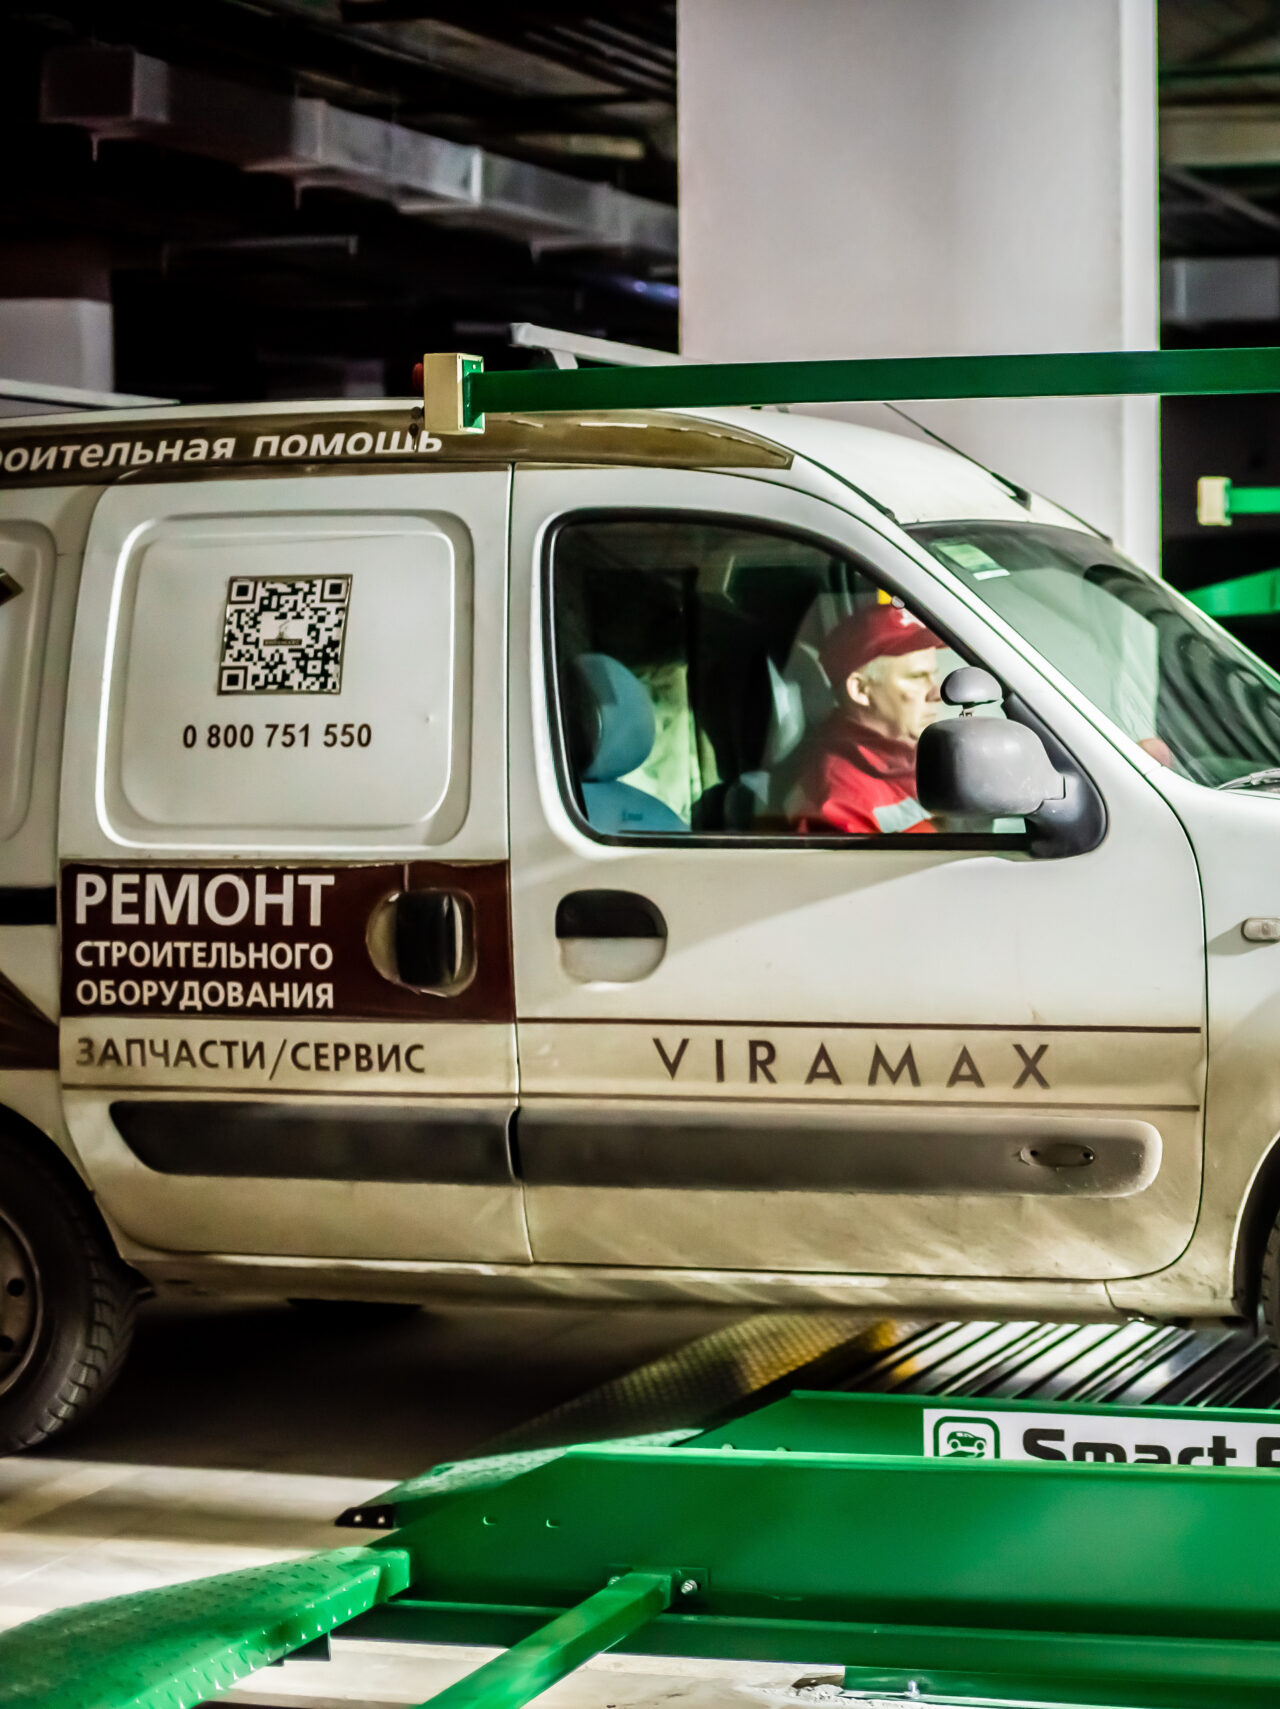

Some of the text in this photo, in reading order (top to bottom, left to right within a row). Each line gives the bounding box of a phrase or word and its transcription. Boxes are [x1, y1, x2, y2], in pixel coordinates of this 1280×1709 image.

[0, 437, 236, 472] оительная
[182, 723, 373, 748] 0 800 751 550
[75, 873, 335, 927] РЕМОНТ
[75, 941, 334, 970] СТРОИТЕЛЬНОГО
[76, 980, 335, 1011] ОБОРУДОВАНИЯ
[76, 1037, 425, 1080] ЗАПЧАСТИ/СЕРВИС
[652, 1037, 1051, 1089] VIRAMAX
